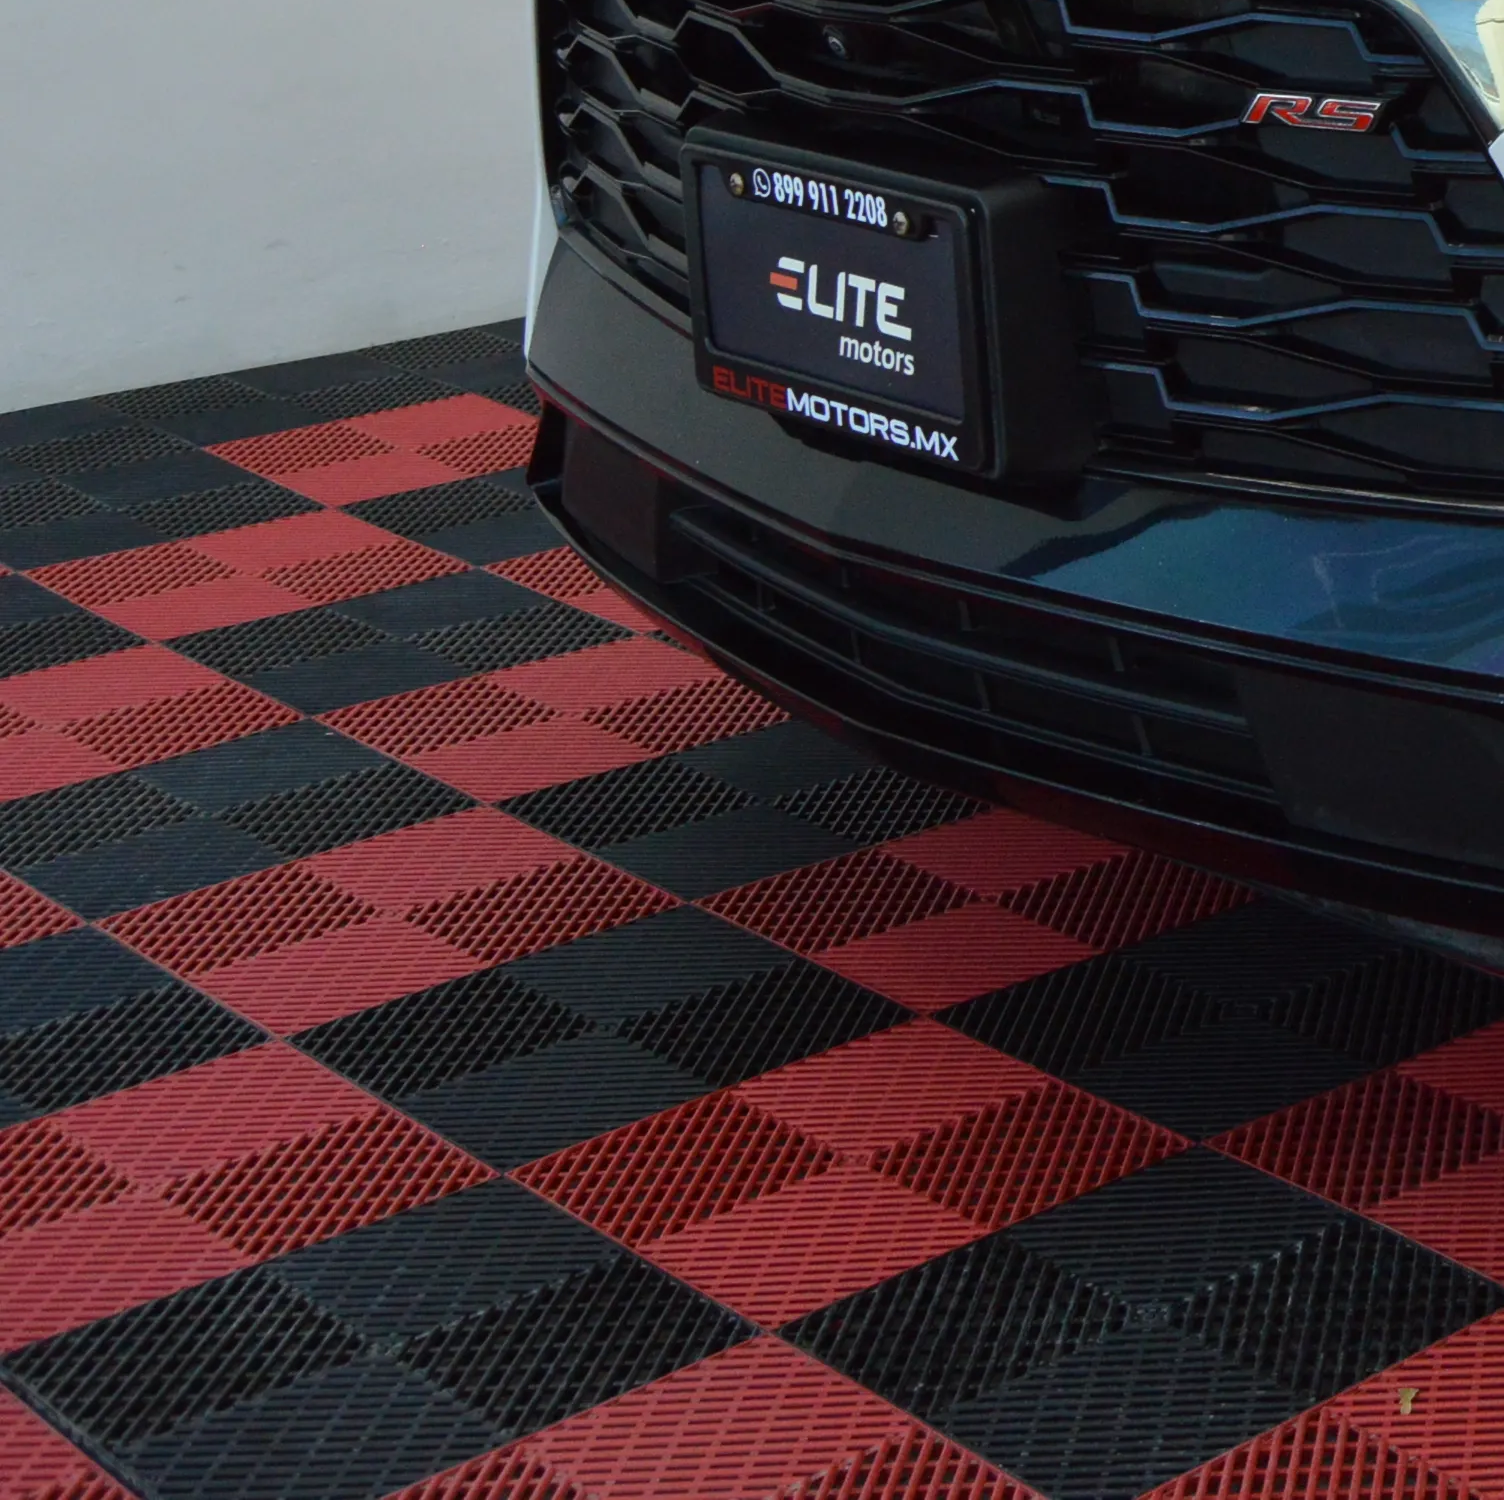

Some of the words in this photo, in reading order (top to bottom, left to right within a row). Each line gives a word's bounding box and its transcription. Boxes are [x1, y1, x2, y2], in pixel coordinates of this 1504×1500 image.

[1241, 93, 1381, 133] RS
[773, 171, 804, 207] 899
[808, 179, 840, 217] 911
[844, 188, 888, 228] 2208
[769, 256, 912, 341] ELITE
[839, 335, 915, 376] motors
[712, 365, 960, 462] ELITEMOTORS.MX
